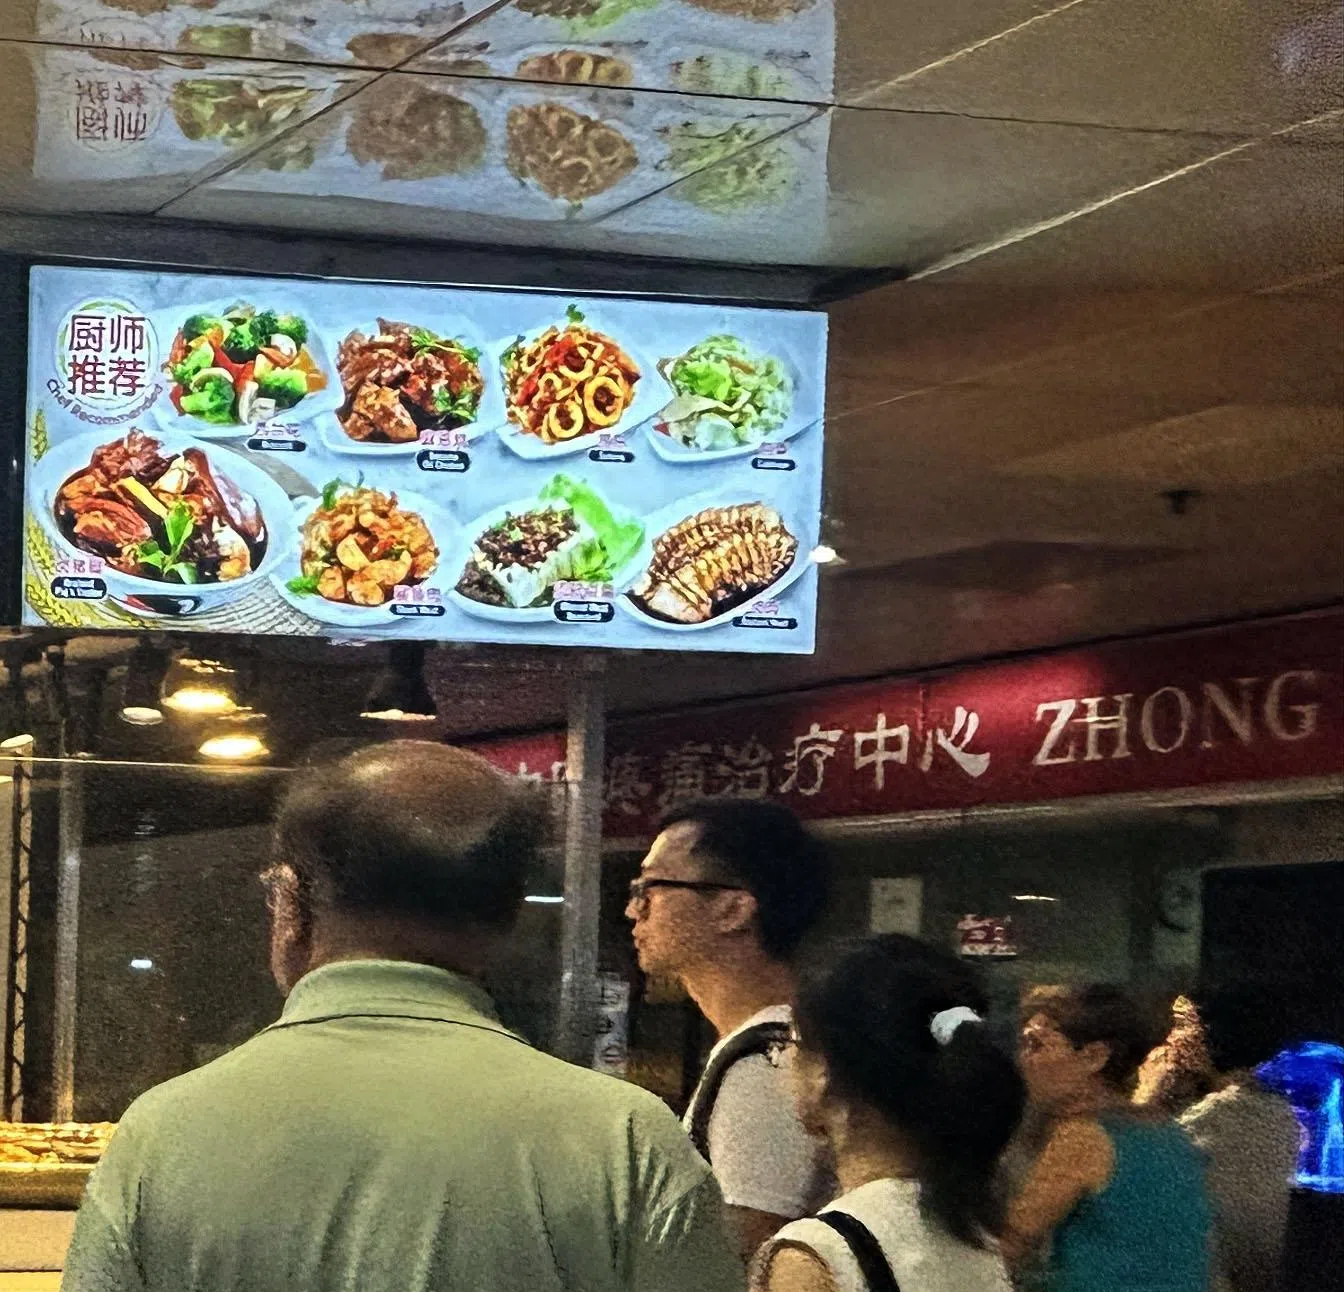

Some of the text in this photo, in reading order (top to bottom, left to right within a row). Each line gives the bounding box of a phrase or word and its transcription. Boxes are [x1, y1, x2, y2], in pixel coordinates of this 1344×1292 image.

[69, 315, 145, 354] 厨师
[68, 355, 145, 397] 推荐
[1031, 668, 1320, 768] ZHONG
